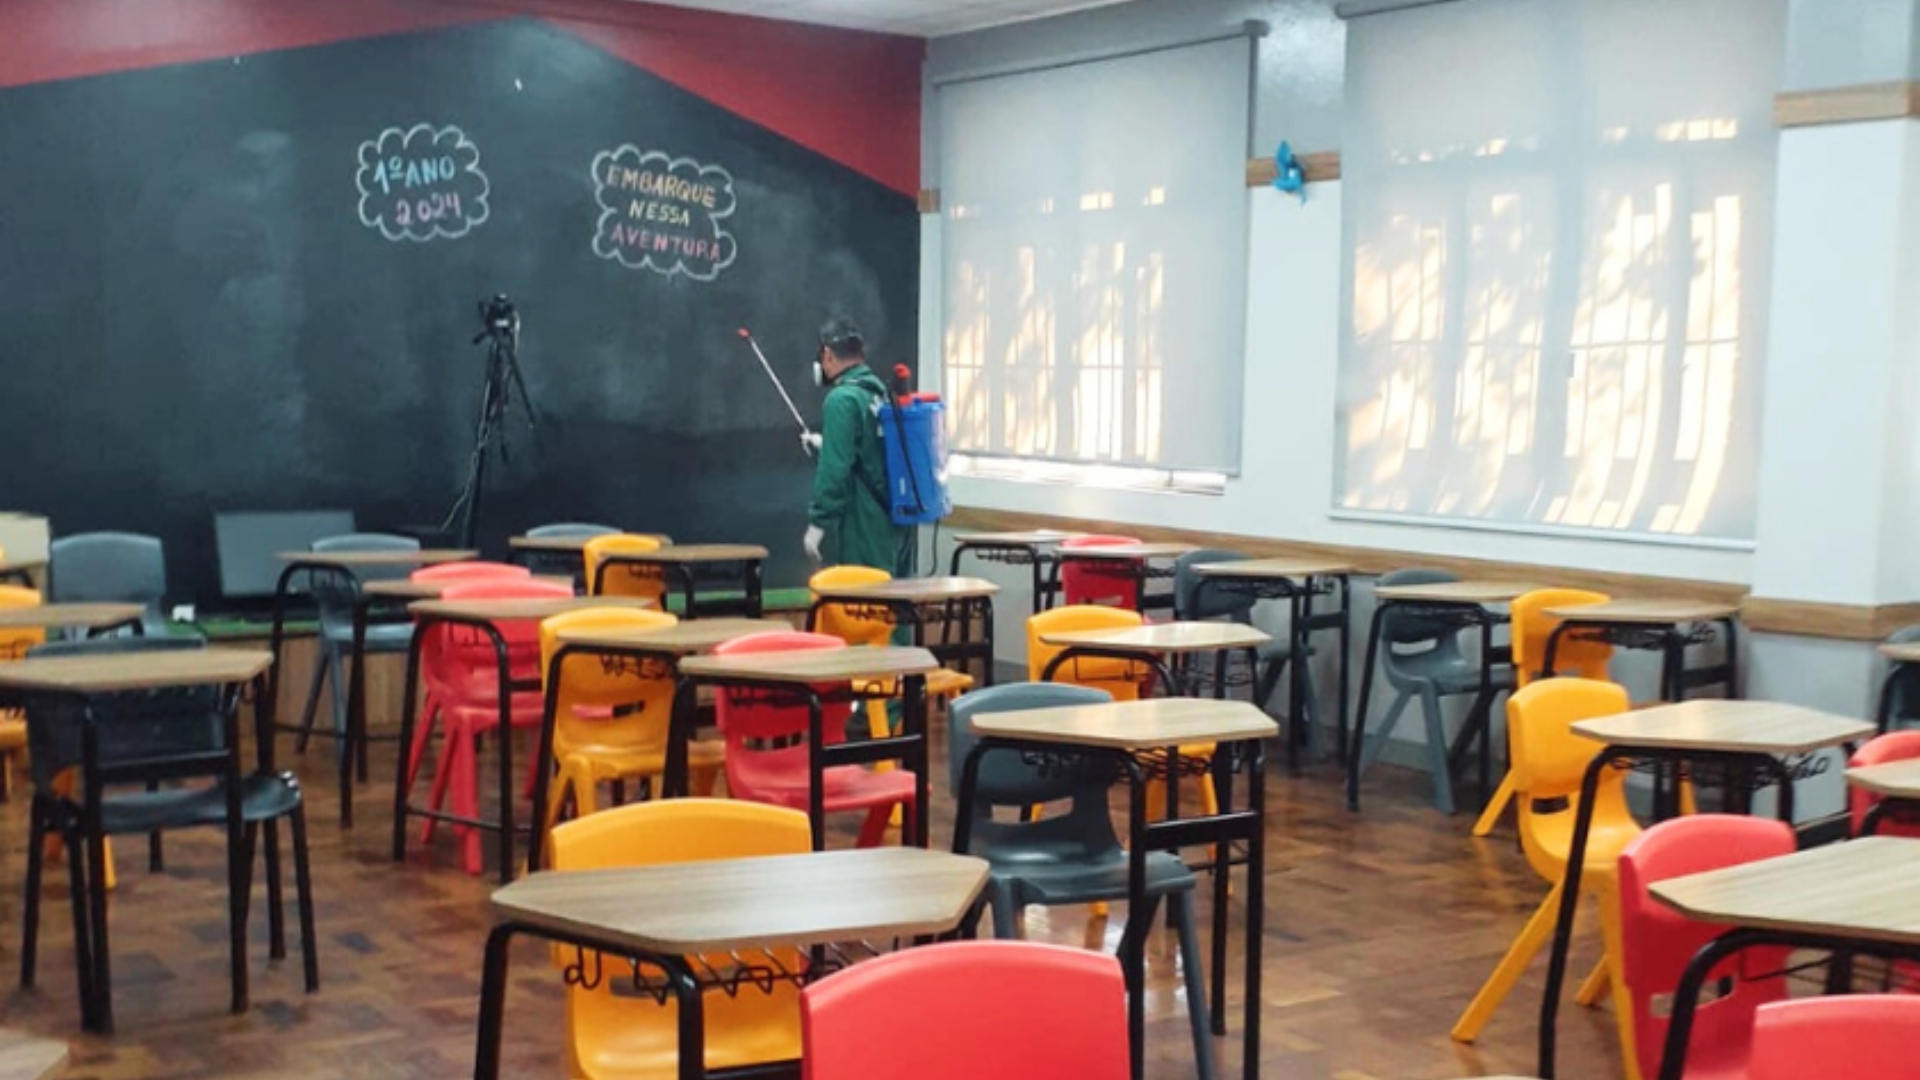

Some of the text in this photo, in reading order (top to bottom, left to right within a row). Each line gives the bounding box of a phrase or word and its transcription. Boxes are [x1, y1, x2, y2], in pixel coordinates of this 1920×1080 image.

[606, 165, 716, 208] EMBARQUE
[395, 191, 461, 226] 2024
[629, 199, 690, 226] NESSA
[611, 223, 721, 261] AVENTURA
